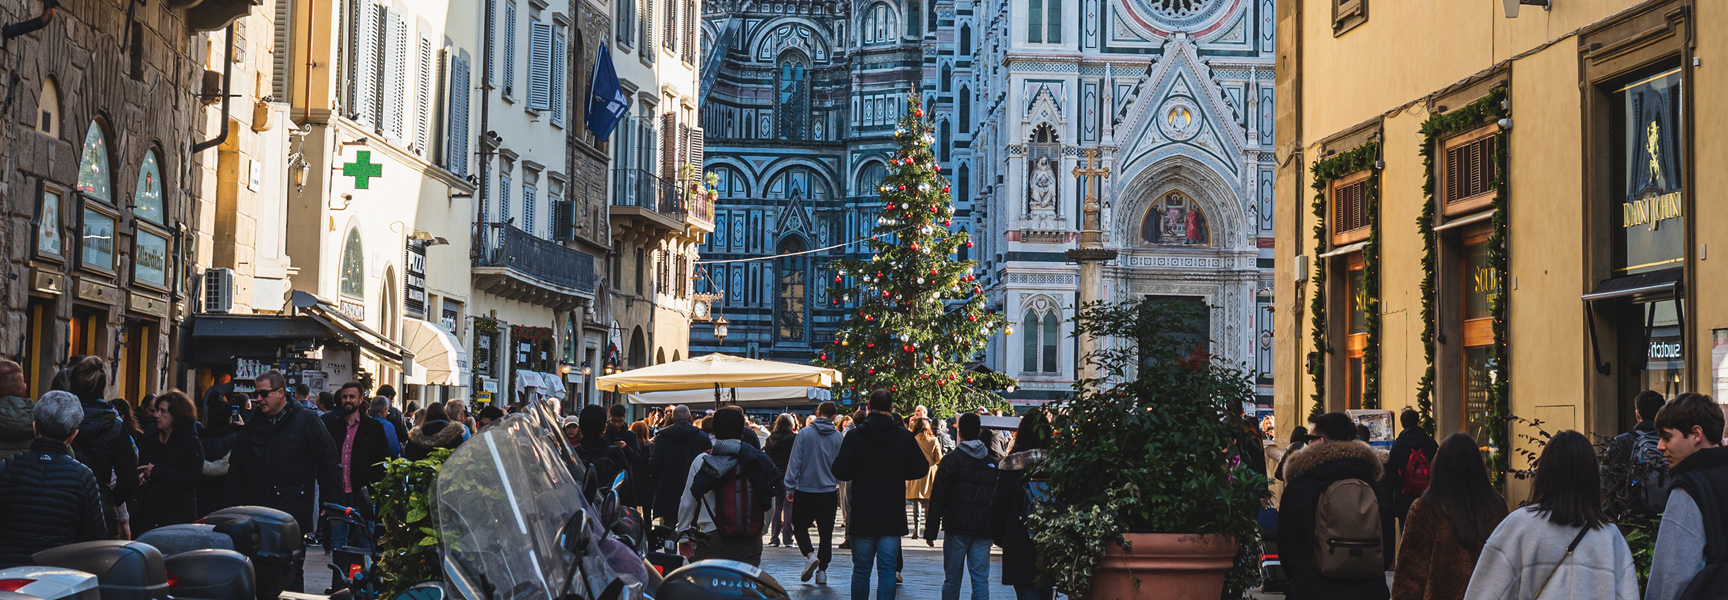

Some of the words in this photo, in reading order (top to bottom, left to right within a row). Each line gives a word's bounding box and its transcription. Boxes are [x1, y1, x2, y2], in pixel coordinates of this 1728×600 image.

[1623, 199, 1650, 228] DAN
[1648, 191, 1682, 231] JOHN
[407, 250, 426, 275] PIZZA
